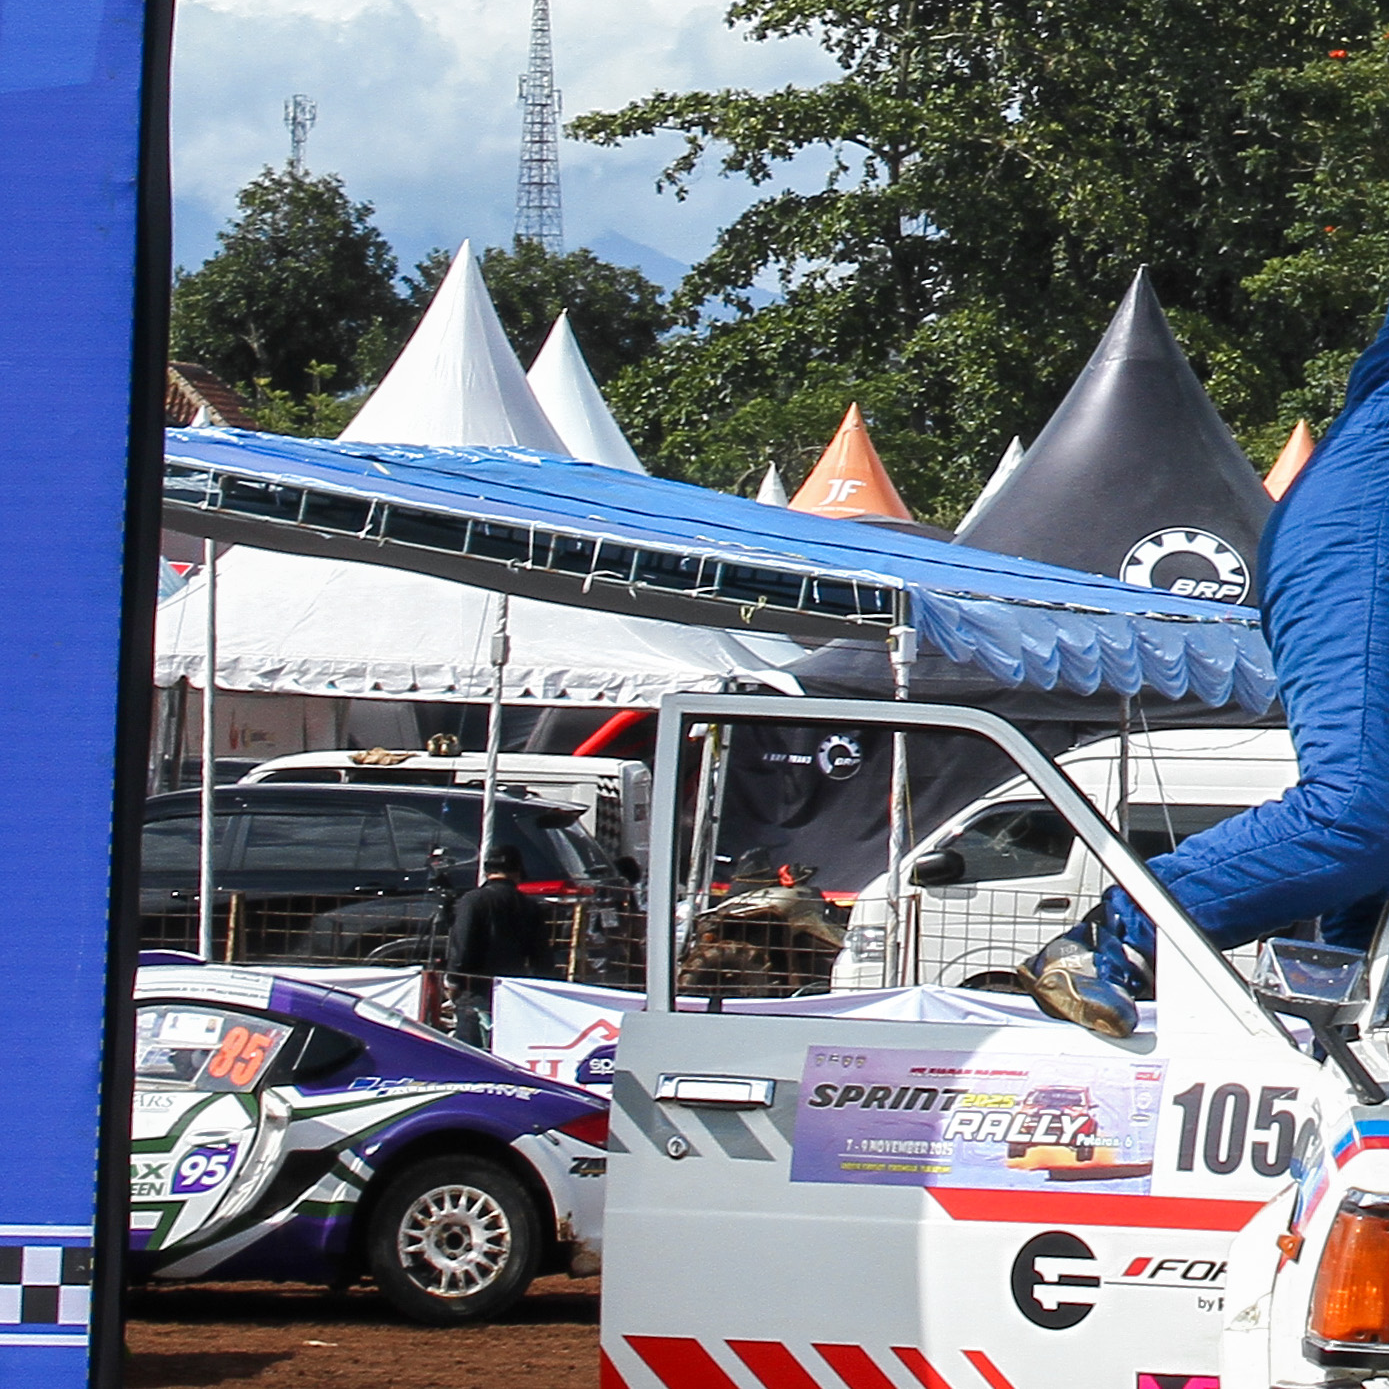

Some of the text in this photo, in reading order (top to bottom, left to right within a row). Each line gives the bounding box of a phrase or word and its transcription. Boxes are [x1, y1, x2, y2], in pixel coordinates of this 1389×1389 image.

[819, 478, 863, 507] JF
[1168, 578, 1244, 600] BRP
[207, 1025, 274, 1088] 85
[133, 1092, 176, 1109] ARS
[807, 1083, 970, 1112] SPRINT
[960, 1092, 1019, 1110] 2025
[944, 1110, 1090, 1145] RALLY
[1172, 1081, 1301, 1178] 105
[868, 1139, 930, 1156] NOVEMBER
[179, 1153, 231, 1187] 95
[129, 1182, 165, 1197] EEN
[1197, 1297, 1215, 1311] by
